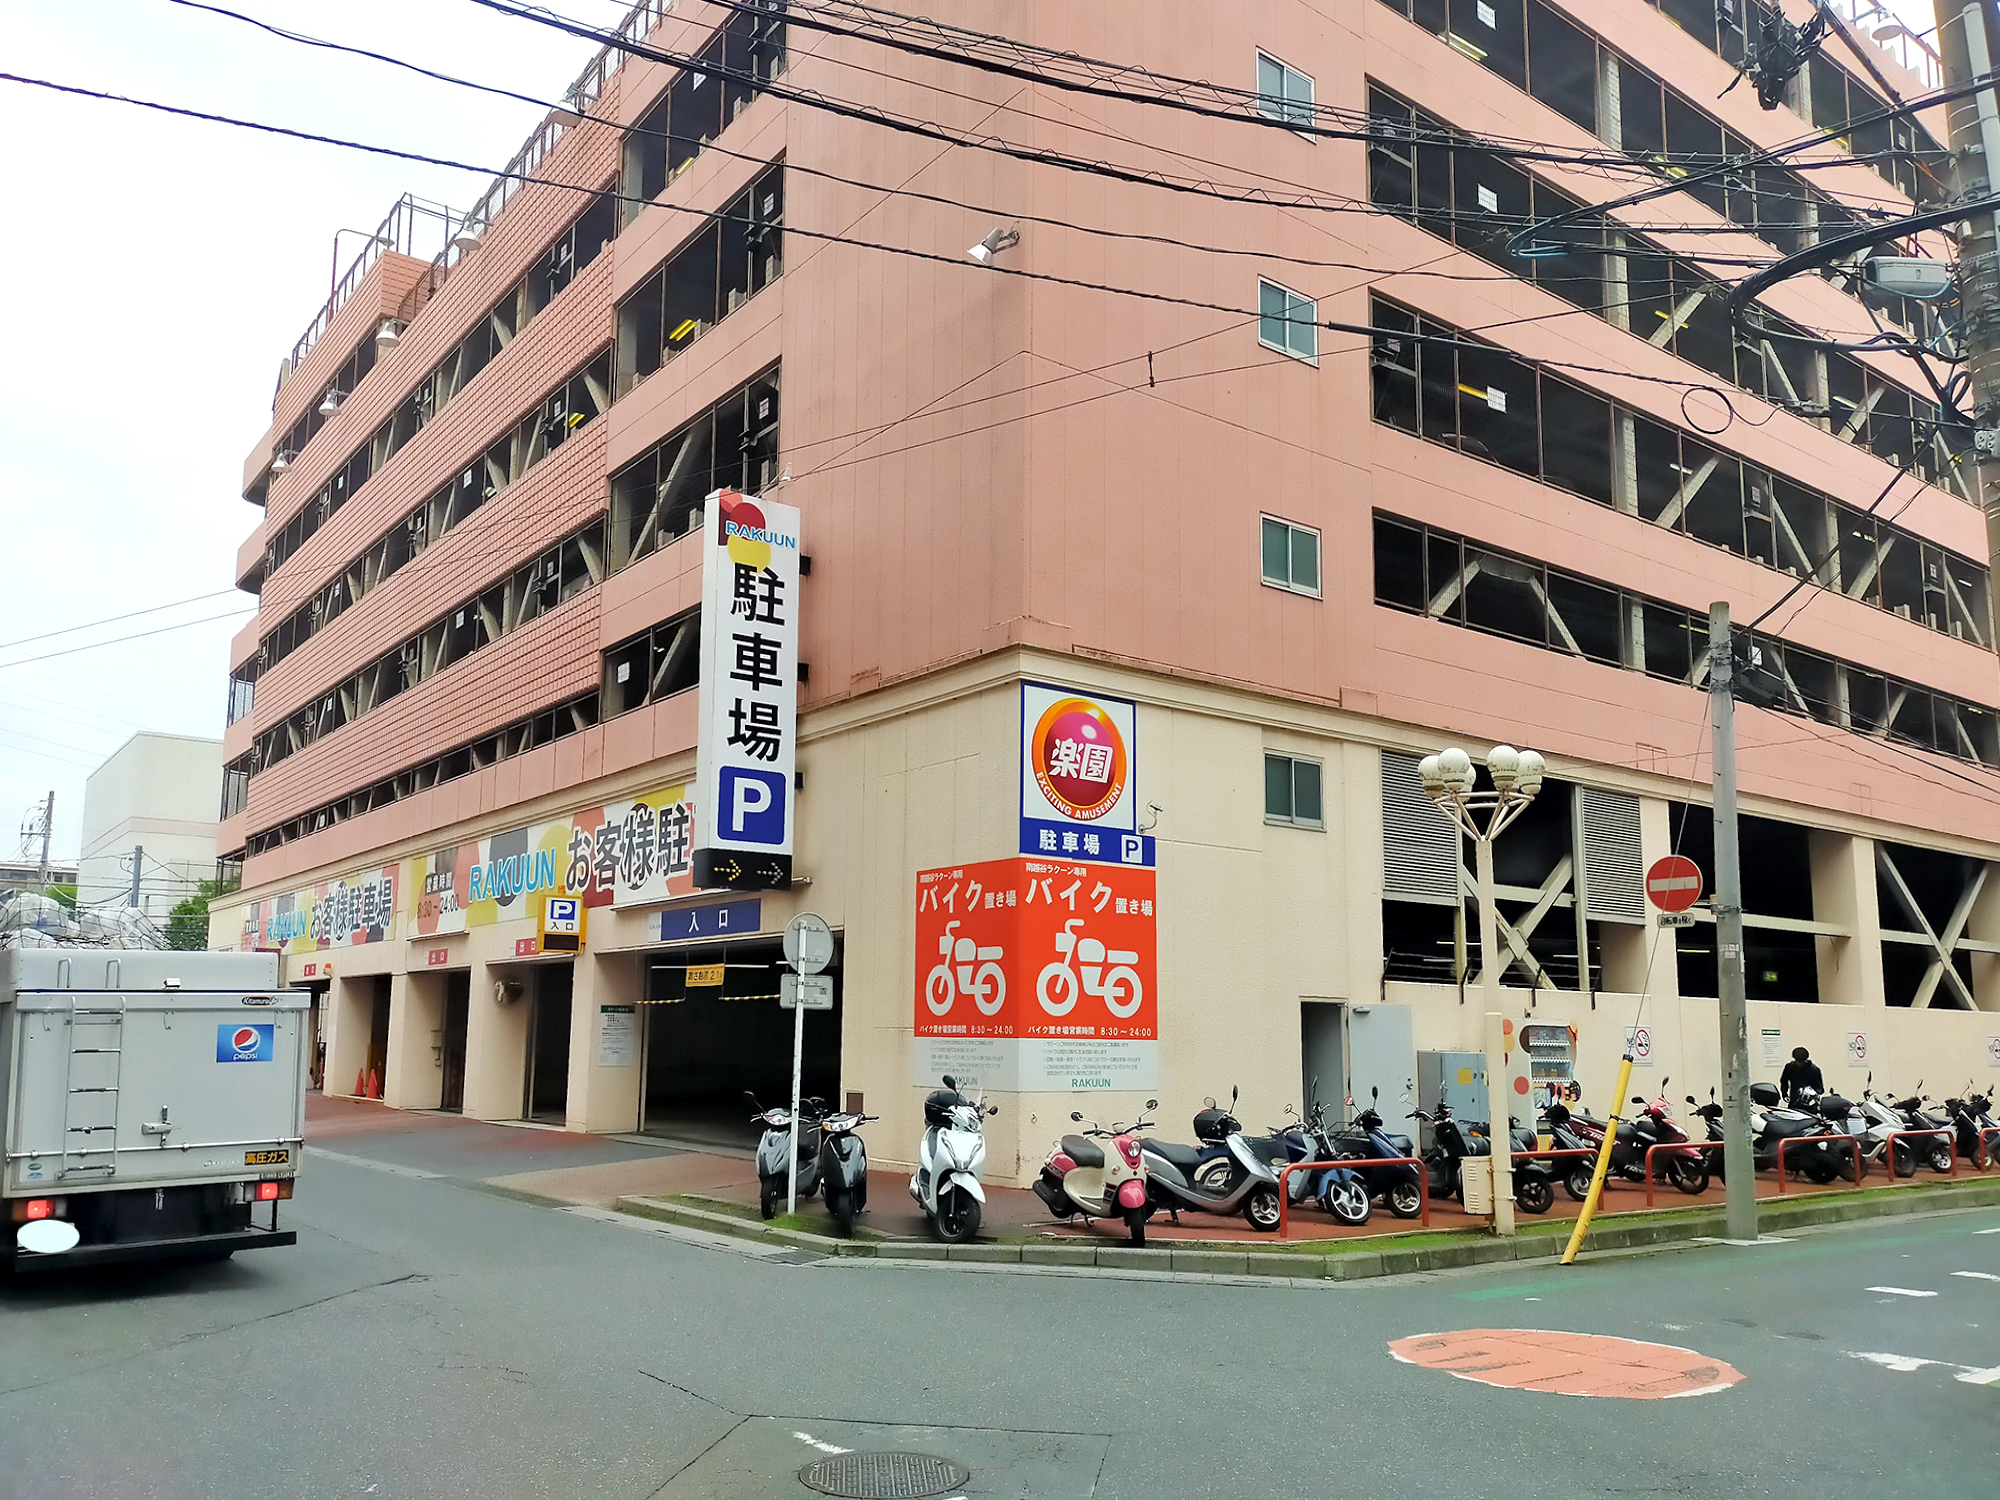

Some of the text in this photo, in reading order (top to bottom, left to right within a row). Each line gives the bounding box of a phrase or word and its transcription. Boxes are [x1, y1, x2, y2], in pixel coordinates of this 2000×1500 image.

[726, 520, 796, 549] RAKUUN
[727, 562, 785, 762] 駐車場
[1049, 738, 1114, 784] 楽園
[732, 776, 772, 832] P
[1036, 771, 1122, 820] EXCITING AMUSEMENT
[468, 800, 697, 902] RAKUUN お客様駐
[1039, 828, 1140, 858] 駐車場 P
[309, 876, 394, 941] お客様駐車場
[553, 901, 573, 919] P
[688, 909, 728, 933] 入口
[550, 922, 574, 931] 入口
[233, 1052, 258, 1061] pepsi
[953, 1075, 978, 1086] AKUUN
[1071, 1078, 1111, 1088] RAKUUN
[245, 1151, 289, 1165] 高圧ガス
